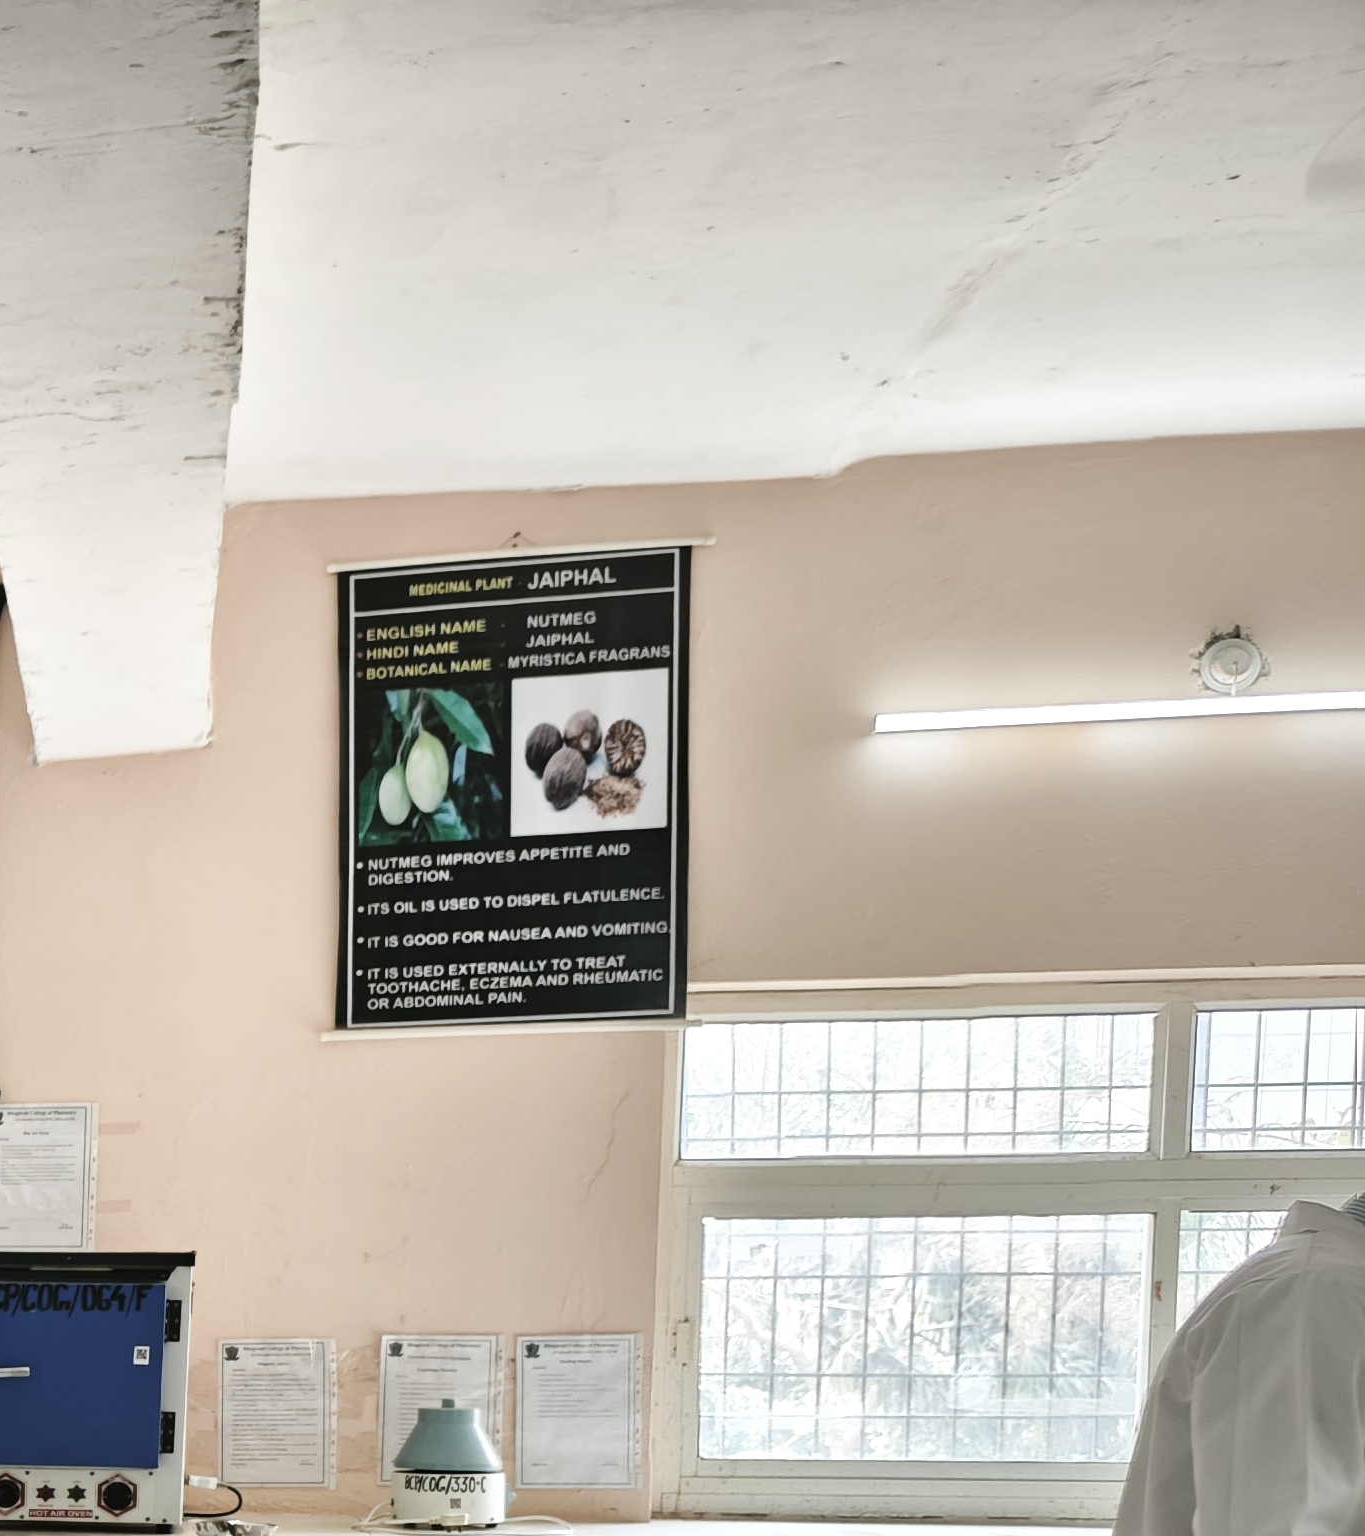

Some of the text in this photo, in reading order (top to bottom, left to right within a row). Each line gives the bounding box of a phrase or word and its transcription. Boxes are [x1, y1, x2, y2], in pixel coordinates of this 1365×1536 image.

[409, 567, 616, 596] MEDICINAL PLANT JAIPHAL
[367, 611, 596, 641] ENGLISH NAME NUTMEG
[367, 632, 594, 660] HINDI NAME JAIPHAL
[367, 645, 670, 680] BOTANICAL NAME MYRISTICA FRAGRANS
[368, 843, 630, 870] NUTMEG IMPROVES APPETITE AND
[368, 870, 453, 886] DIGESTION.
[368, 887, 664, 915] ITS OIL IS USED TO DISPEL FLATULENCE.
[368, 936, 380, 948] IT
[385, 935, 398, 947] IS
[403, 933, 448, 946] GOOD
[453, 931, 484, 943] FOR
[488, 927, 552, 942] NAUSEA
[555, 925, 588, 938] AND
[368, 955, 625, 980] IT IS USED EXTERNALLY TO TREAT
[470, 976, 532, 989] ECZEMA
[536, 974, 569, 986] AND
[573, 969, 663, 985] RHEUMATIC
[367, 992, 526, 1010] OR ABDOMINAL PAIN.
